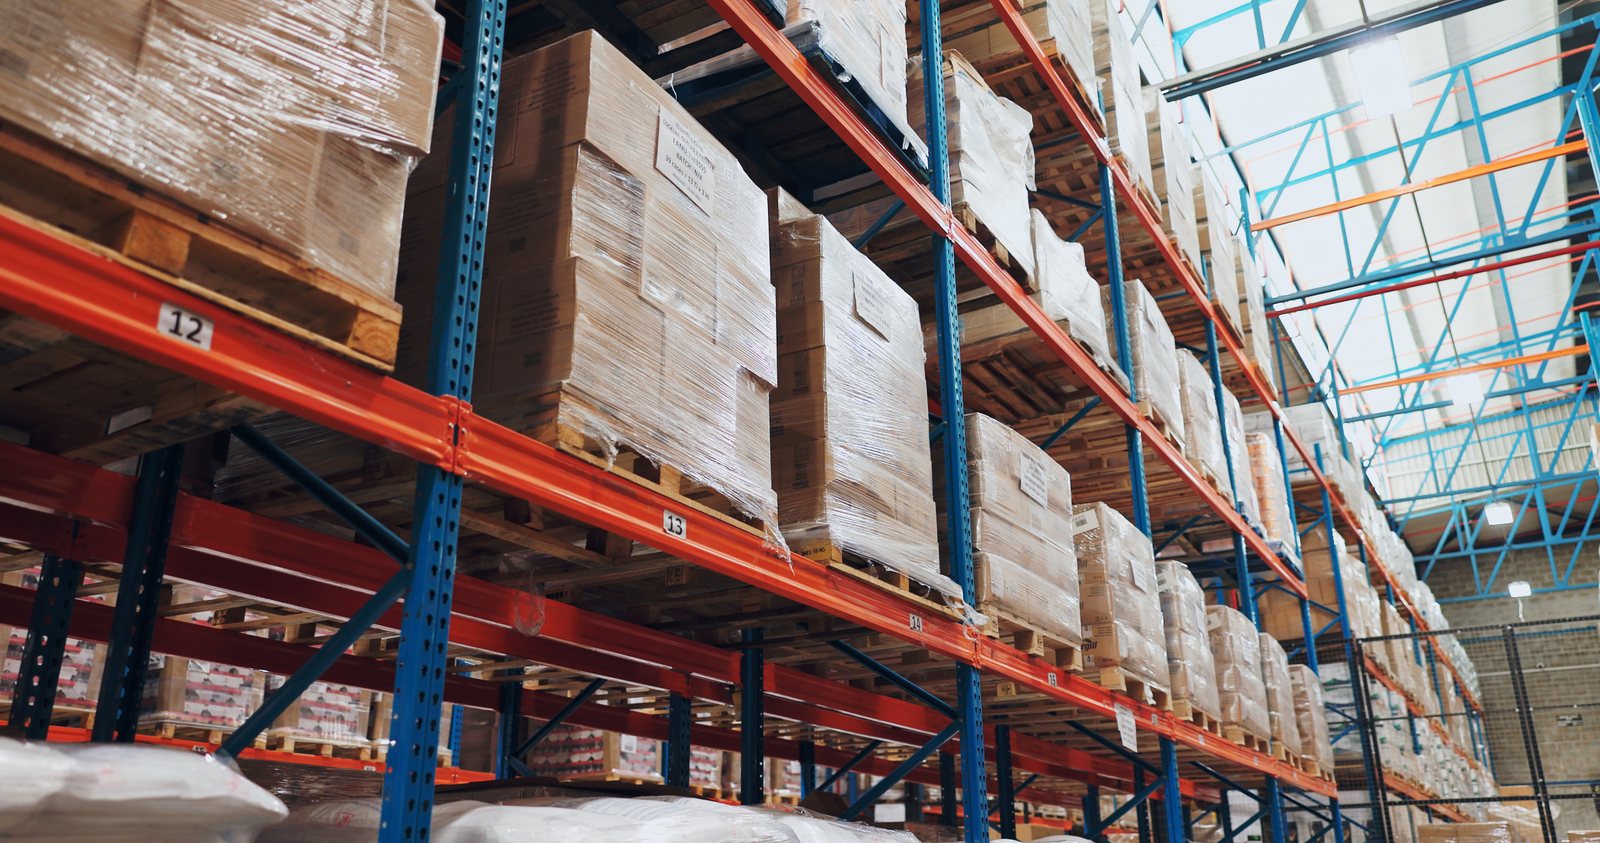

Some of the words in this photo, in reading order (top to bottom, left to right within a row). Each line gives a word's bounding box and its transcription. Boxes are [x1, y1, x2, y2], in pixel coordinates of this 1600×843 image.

[169, 310, 203, 344] 12
[667, 515, 683, 535] 13
[912, 616, 921, 630] 14
